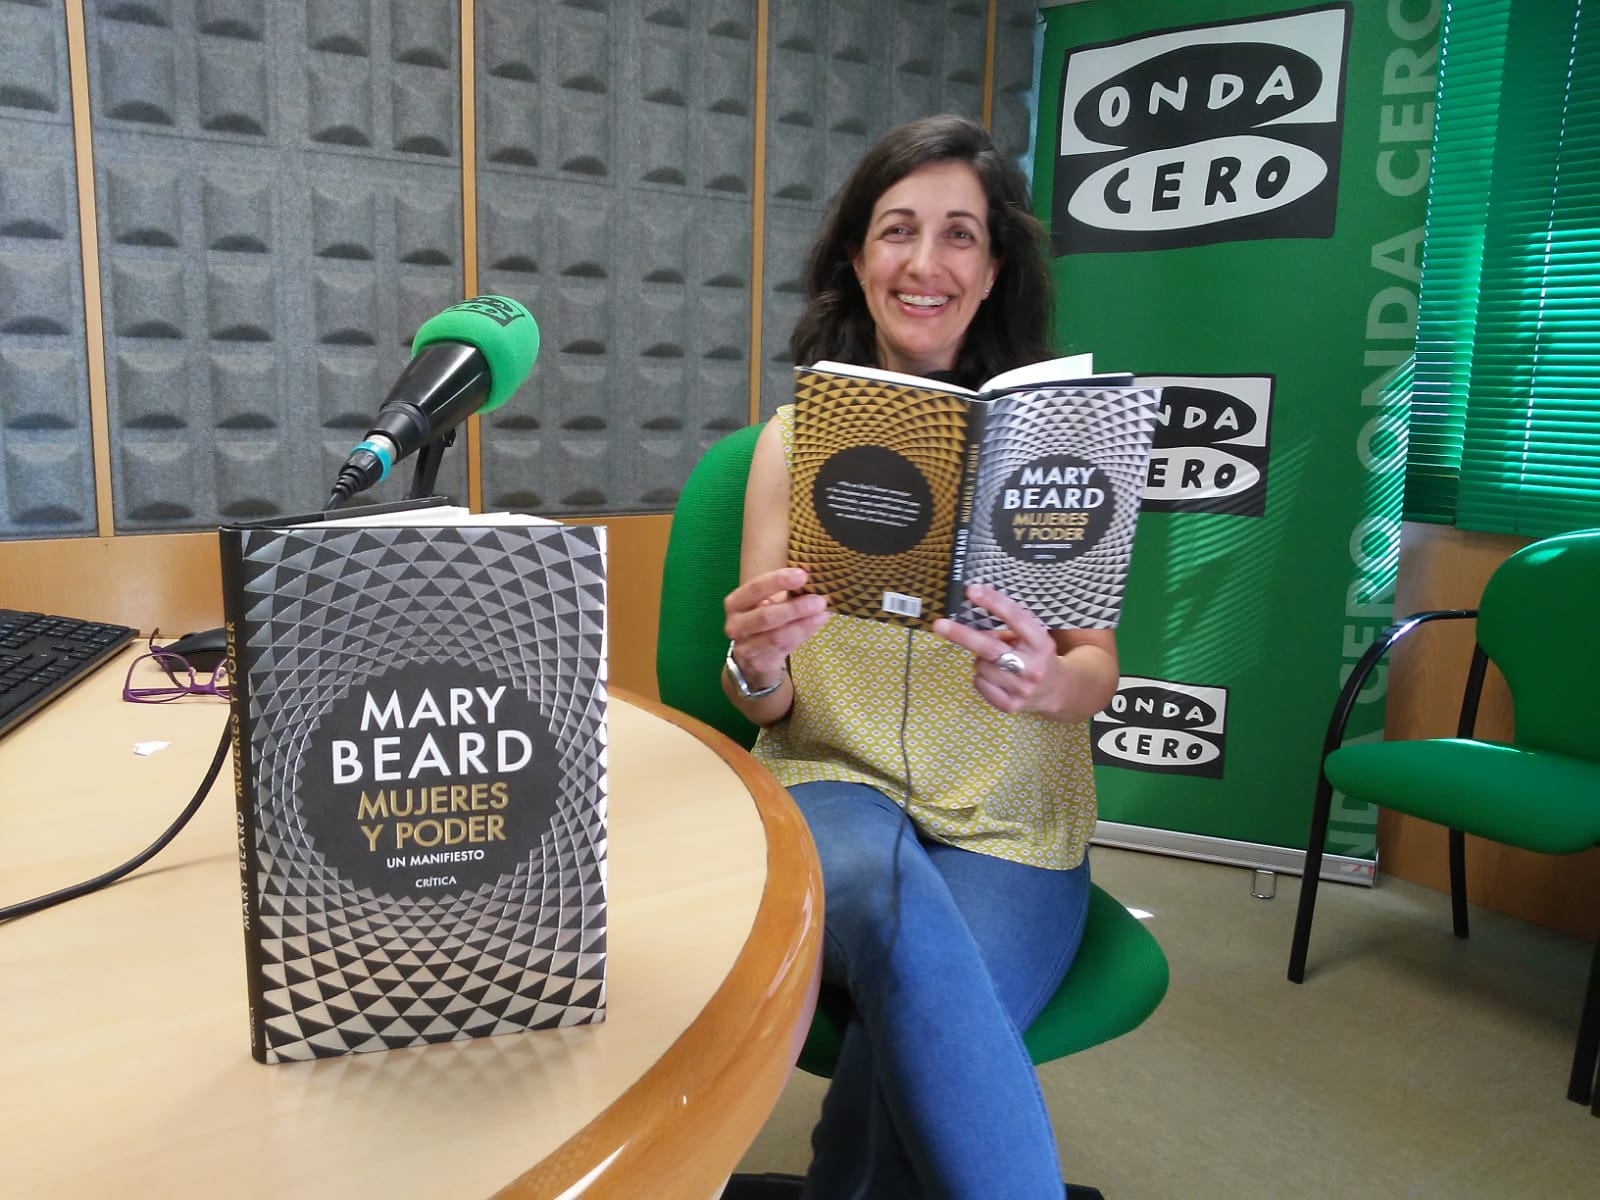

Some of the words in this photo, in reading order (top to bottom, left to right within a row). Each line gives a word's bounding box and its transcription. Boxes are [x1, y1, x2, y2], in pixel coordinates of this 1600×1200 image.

[1098, 65, 1294, 127] ONDA
[1103, 156, 1291, 214] CERO
[1356, 226, 1425, 474] ONDA
[1156, 404, 1239, 430] NDA
[1020, 466, 1097, 485] MARY
[1146, 457, 1237, 489] ERO
[1003, 487, 1105, 510] BEARD
[1012, 512, 1089, 526] MUJERES
[1013, 527, 1026, 540] Y
[1028, 527, 1085, 541] PODER
[226, 621, 238, 685] PODER
[360, 686, 506, 732] MARY
[1111, 694, 1204, 722] ONDA
[231, 713, 243, 797] MUJERES
[331, 730, 533, 784] BEARD
[1114, 731, 1203, 760] CERO
[357, 782, 510, 820] MUJERES
[360, 824, 384, 852] Y
[396, 814, 506, 849] PODER
[386, 856, 406, 869] UN
[410, 849, 485, 867] MANIFIESTO
[415, 875, 457, 889] CRÍTICA
[242, 881, 251, 930] MARY
